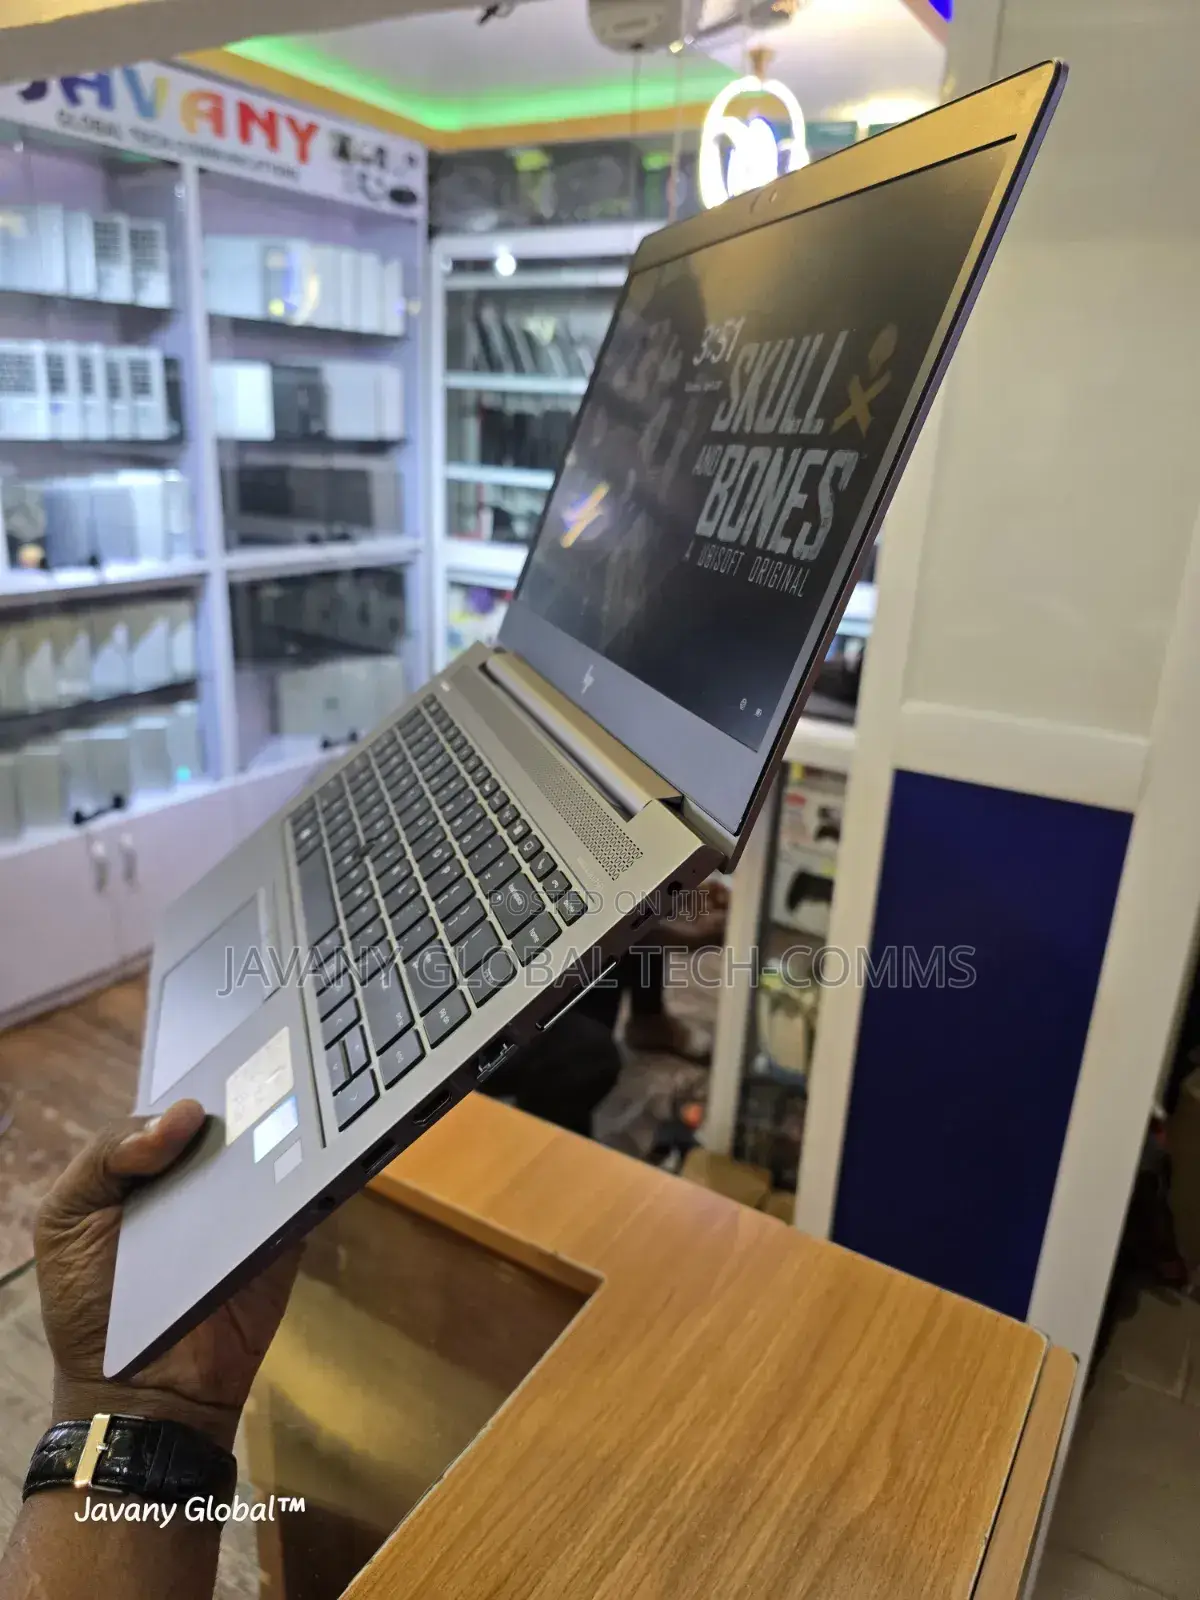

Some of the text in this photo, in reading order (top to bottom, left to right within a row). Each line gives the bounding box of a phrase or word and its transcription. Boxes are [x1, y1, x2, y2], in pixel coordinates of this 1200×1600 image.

[17, 65, 320, 166] AVANY
[710, 330, 848, 436] SKULL
[695, 444, 859, 561] BONES
[697, 544, 746, 577] UBISOFT
[747, 555, 811, 598] ORIGINAL
[528, 927, 540, 944] home
